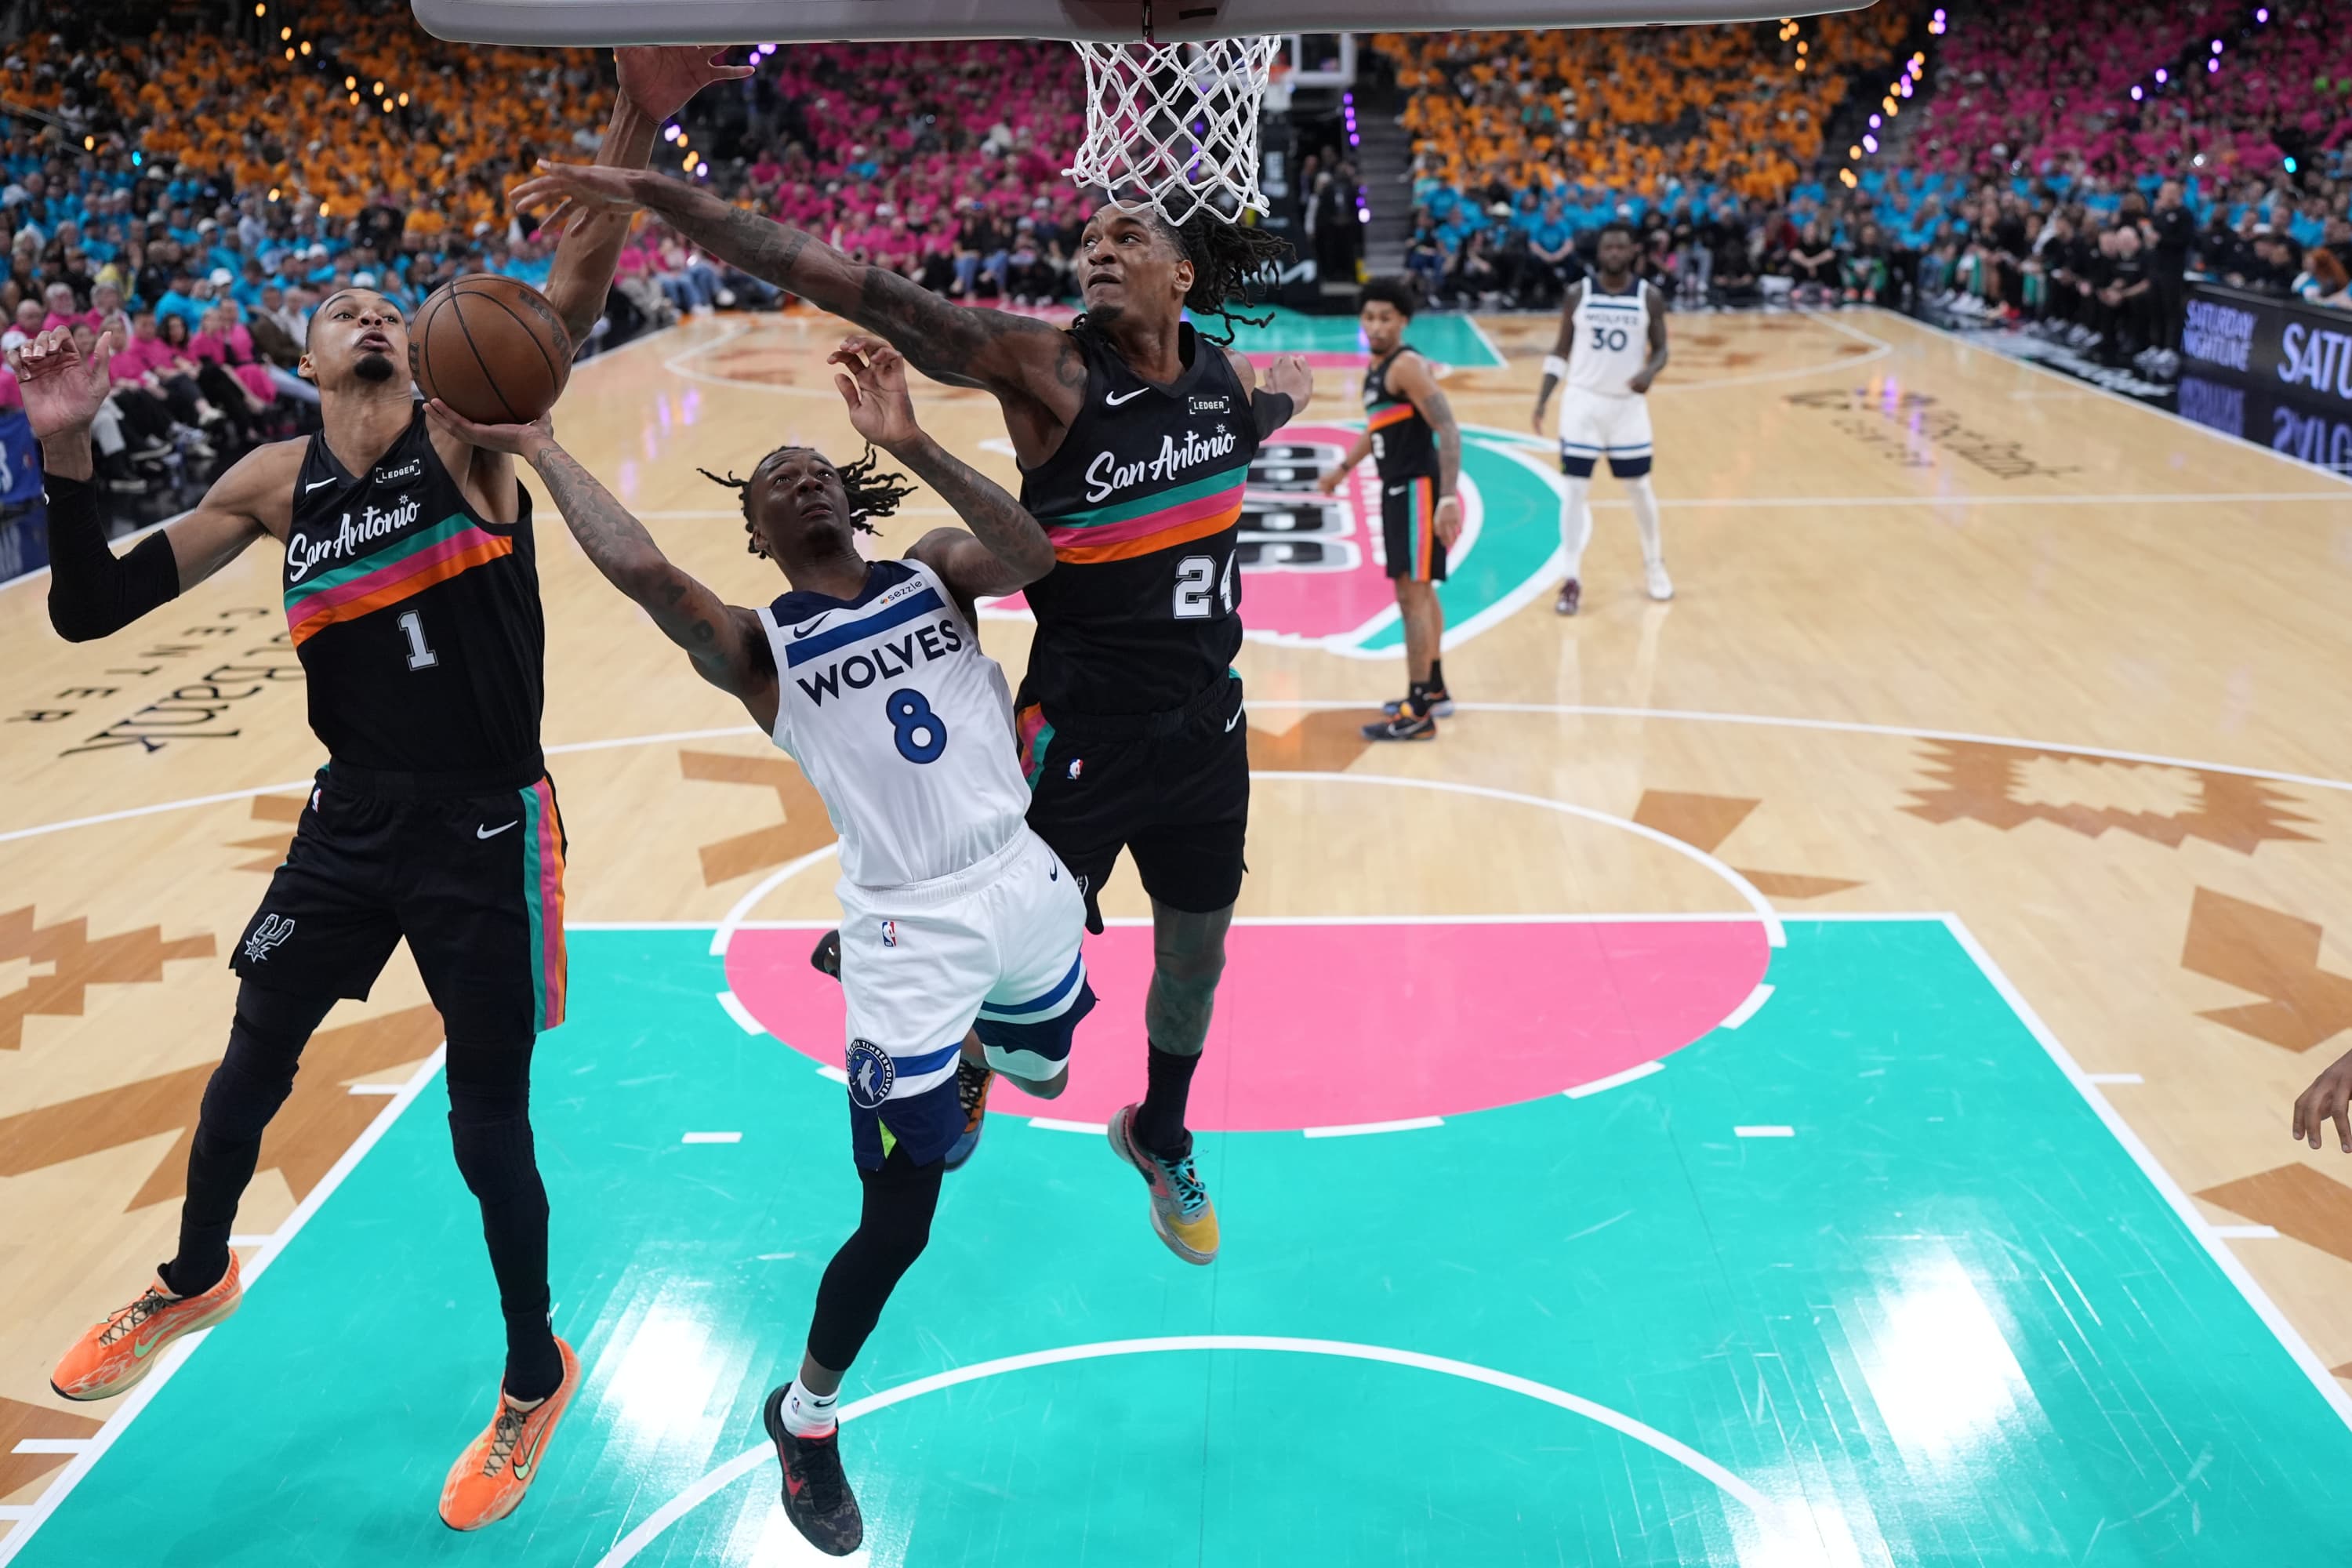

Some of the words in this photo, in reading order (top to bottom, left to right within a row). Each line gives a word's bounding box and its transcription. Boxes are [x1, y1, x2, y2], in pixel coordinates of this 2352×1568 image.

[1591, 327, 1628, 352] 30
[1193, 401, 1225, 410] LEDGER
[382, 465, 415, 480] LEDGER
[1085, 451, 1145, 503] San
[1148, 424, 1236, 481] Antonio
[287, 533, 330, 583] San
[333, 495, 421, 558] Antonio
[887, 579, 923, 601] sezzle
[1172, 549, 1236, 619] 24
[397, 609, 439, 671] 1
[796, 619, 962, 707] WOLVES
[886, 688, 947, 764] 8
[862, 1041, 892, 1098] TIMBERWOLVES
